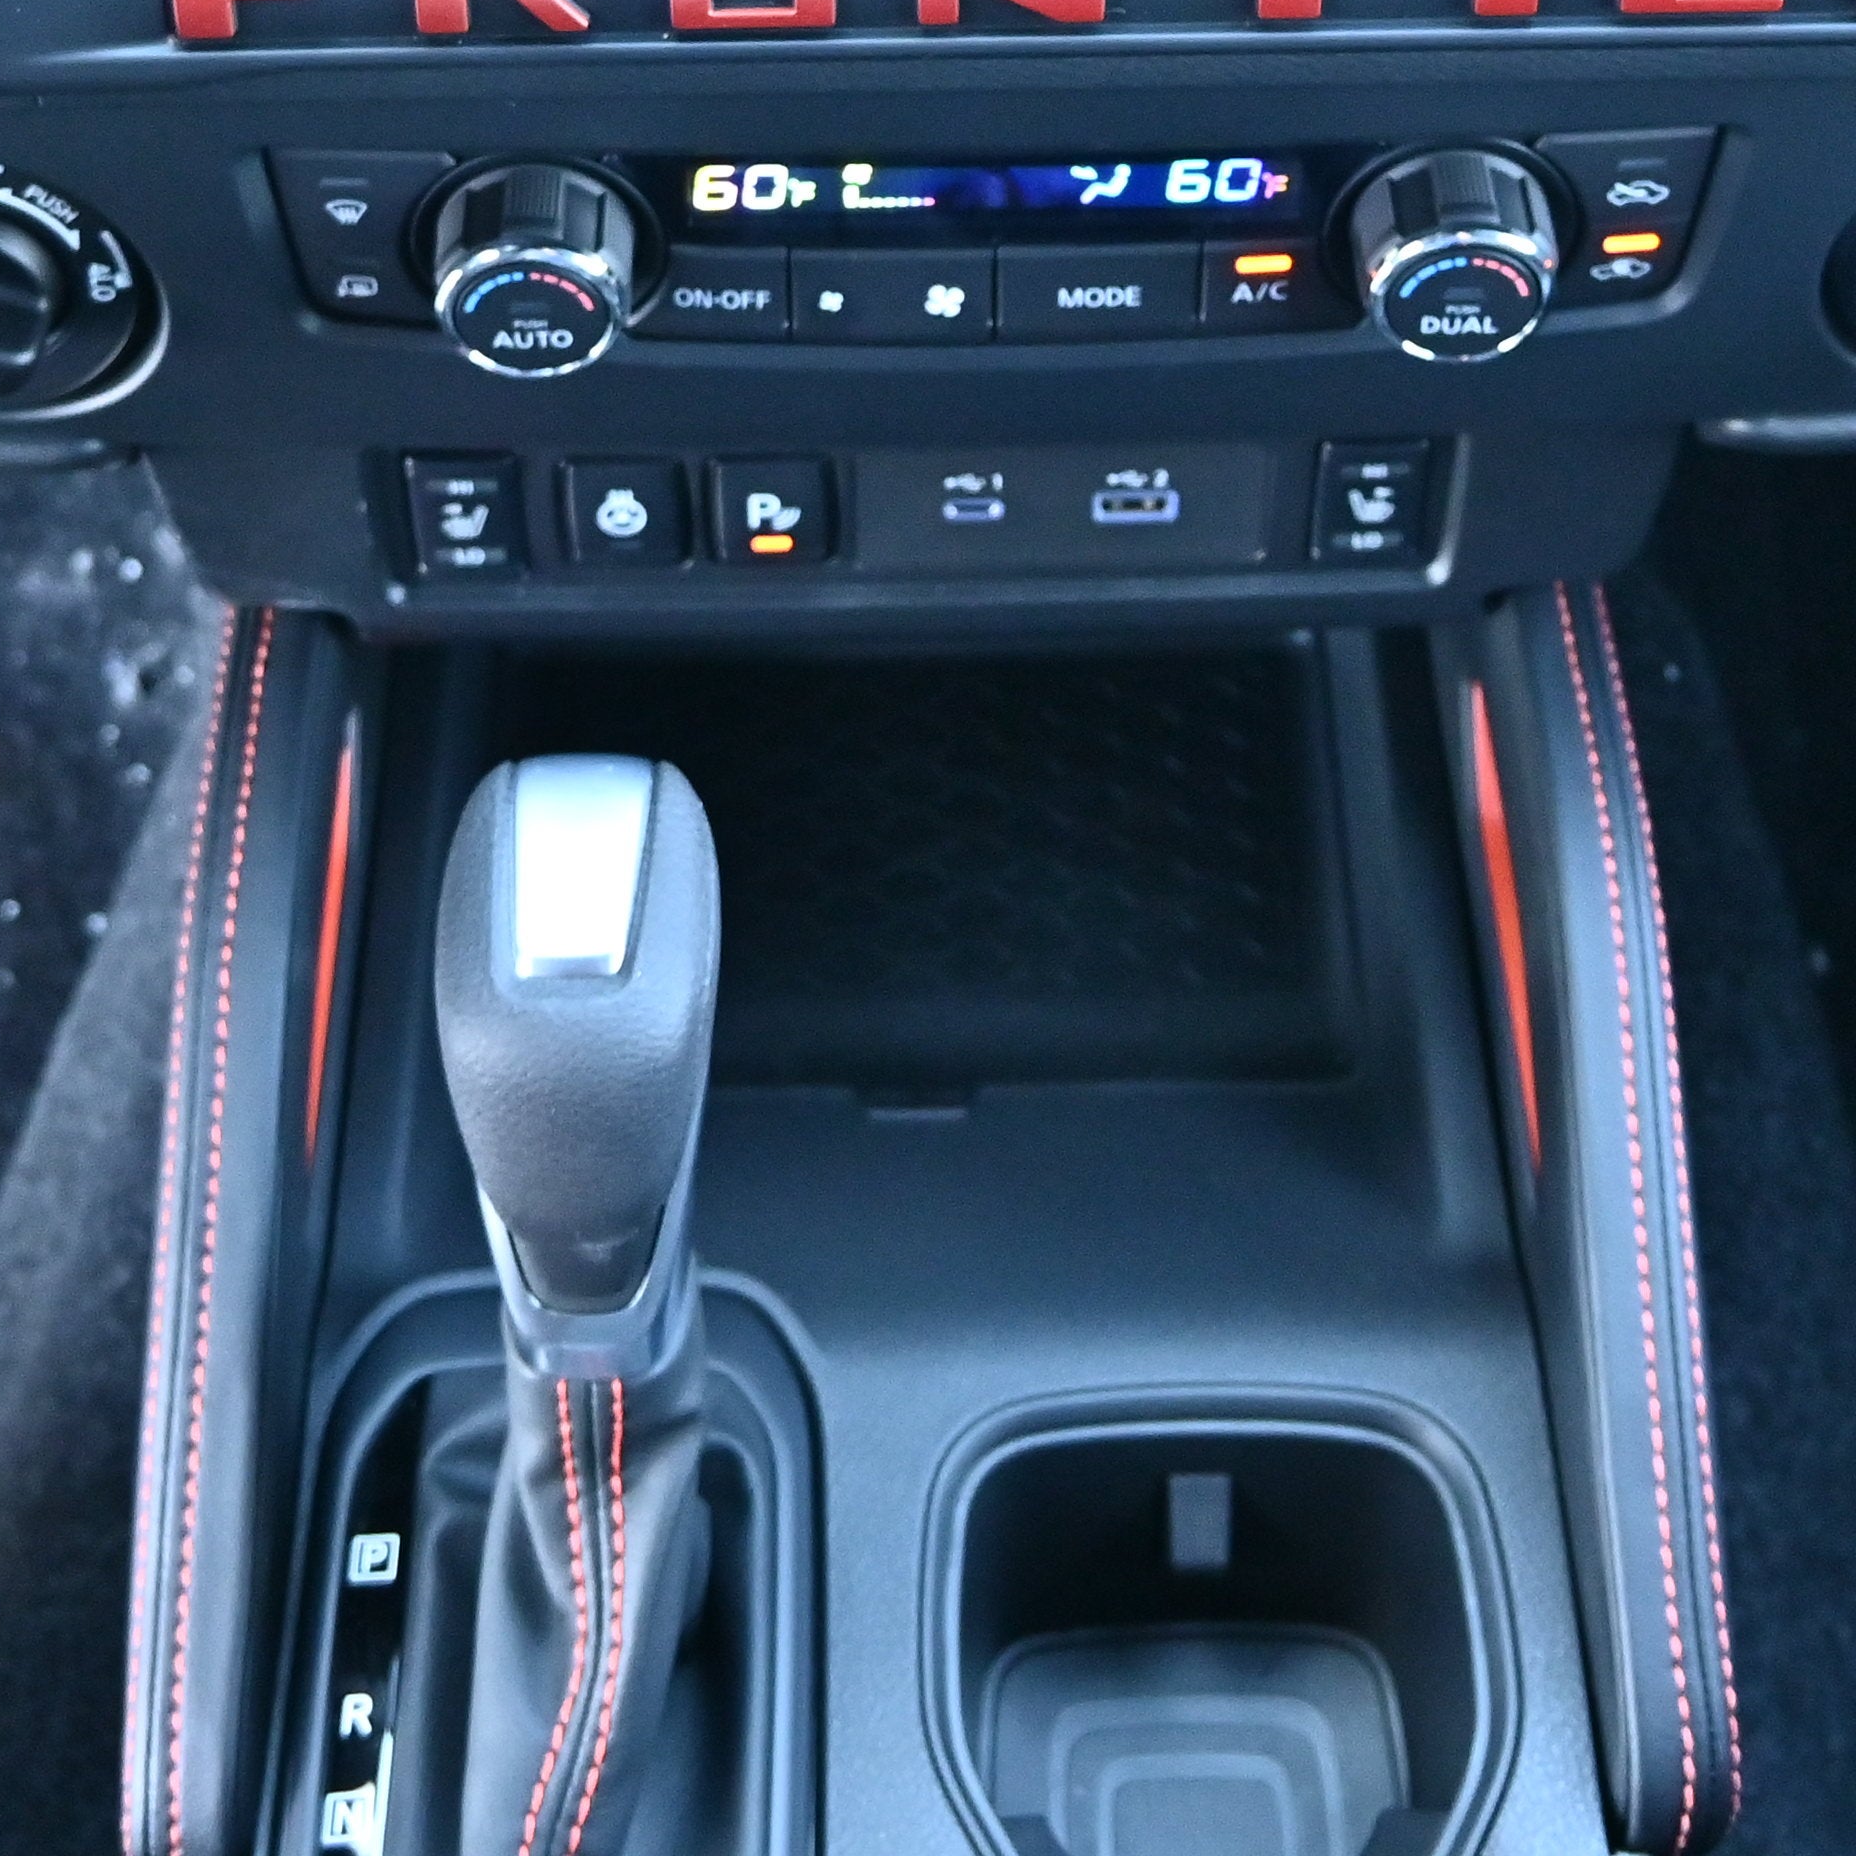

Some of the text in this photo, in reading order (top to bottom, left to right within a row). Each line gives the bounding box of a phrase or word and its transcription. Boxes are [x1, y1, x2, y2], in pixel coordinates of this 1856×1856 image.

[1057, 286, 1142, 309] MODE
[1231, 281, 1288, 304] A/C
[1420, 315, 1498, 335] DUAL
[492, 329, 574, 349] AUTO
[359, 1542, 388, 1574] P
[340, 1693, 373, 1740] R
